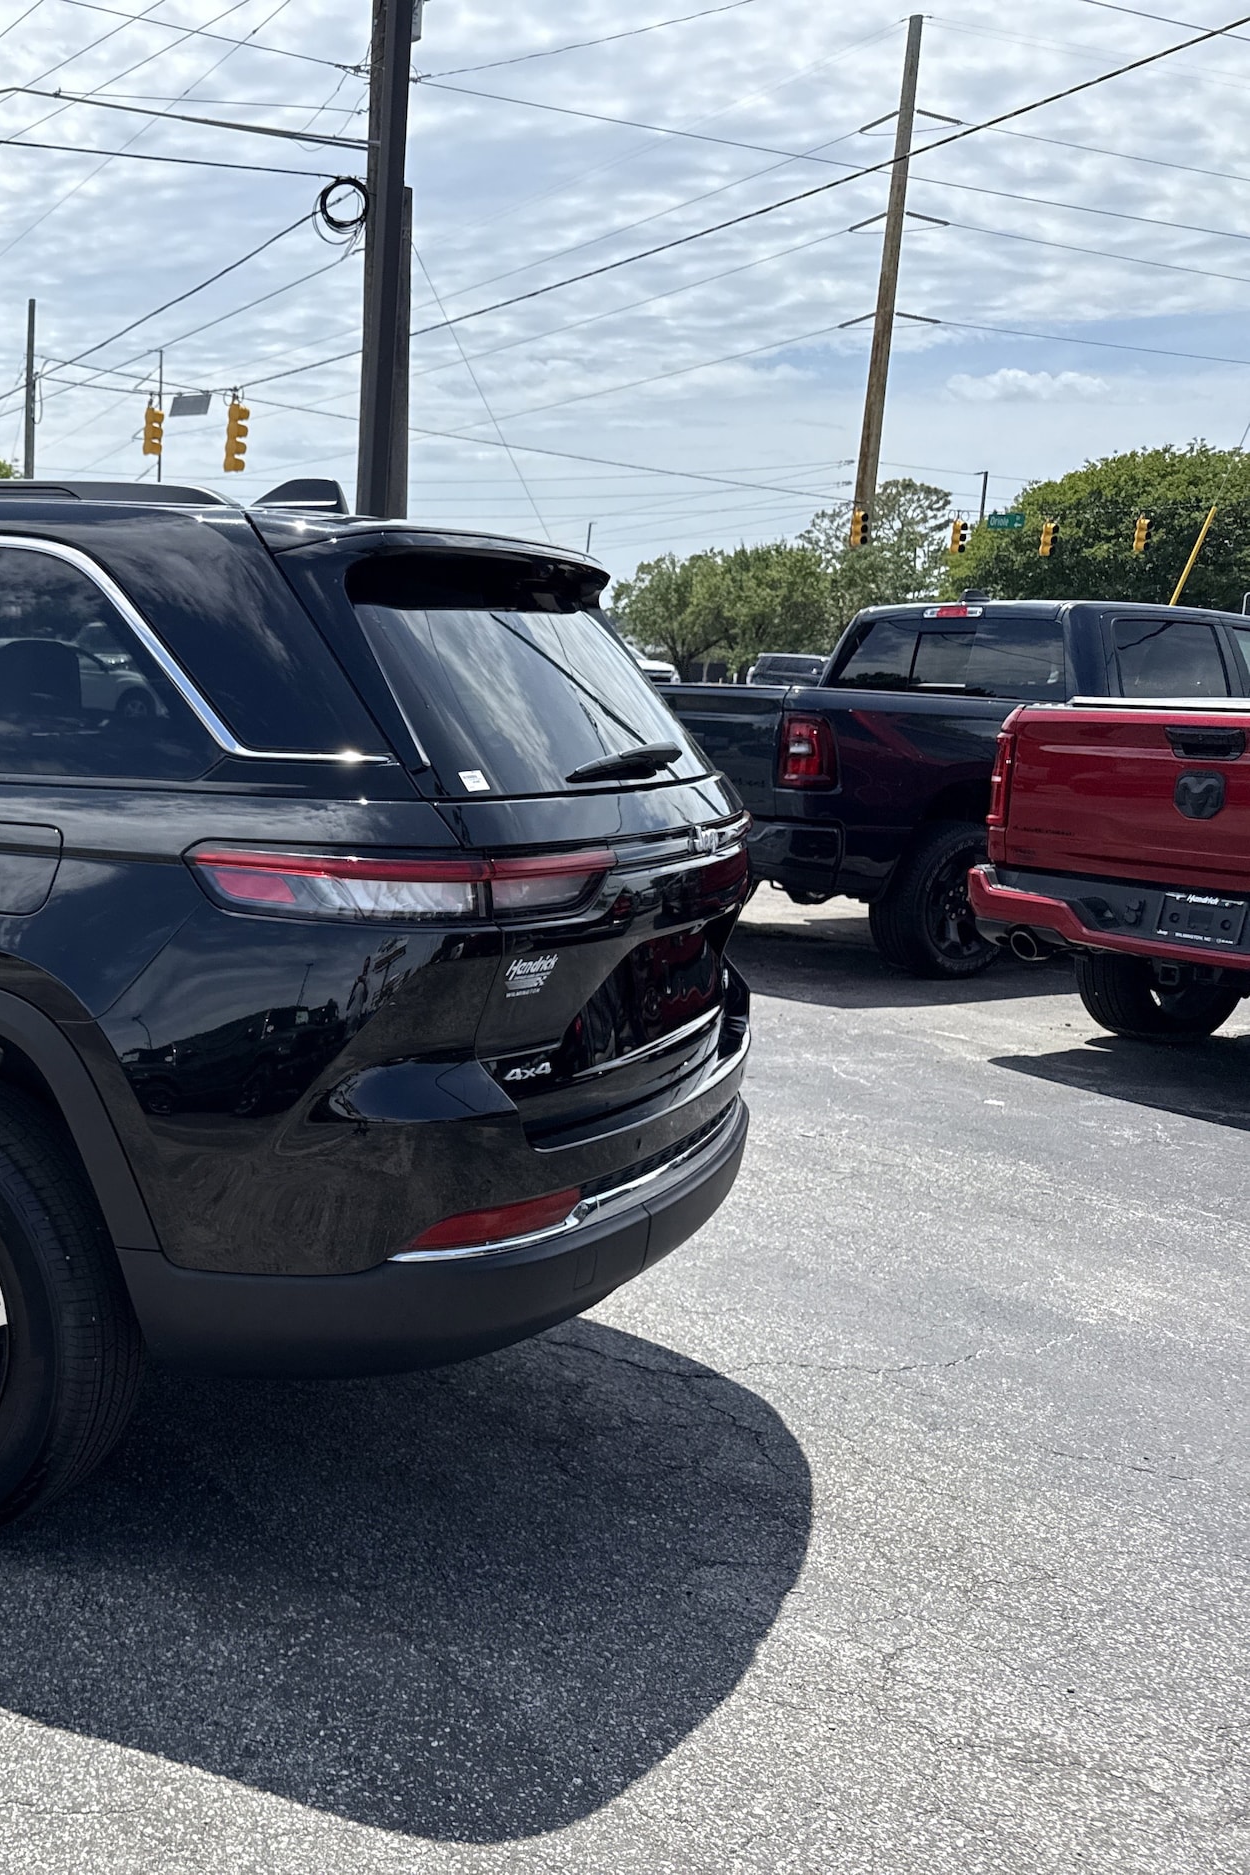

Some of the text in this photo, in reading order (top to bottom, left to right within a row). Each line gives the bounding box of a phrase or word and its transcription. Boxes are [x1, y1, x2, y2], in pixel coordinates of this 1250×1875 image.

[990, 515, 1009, 527] Oriole
[694, 825, 719, 854] Jeep
[1186, 893, 1219, 906] Hendrick
[505, 953, 559, 981] Hendrick
[505, 987, 541, 998] WILMINGTON
[504, 1061, 552, 1081] 4x4
